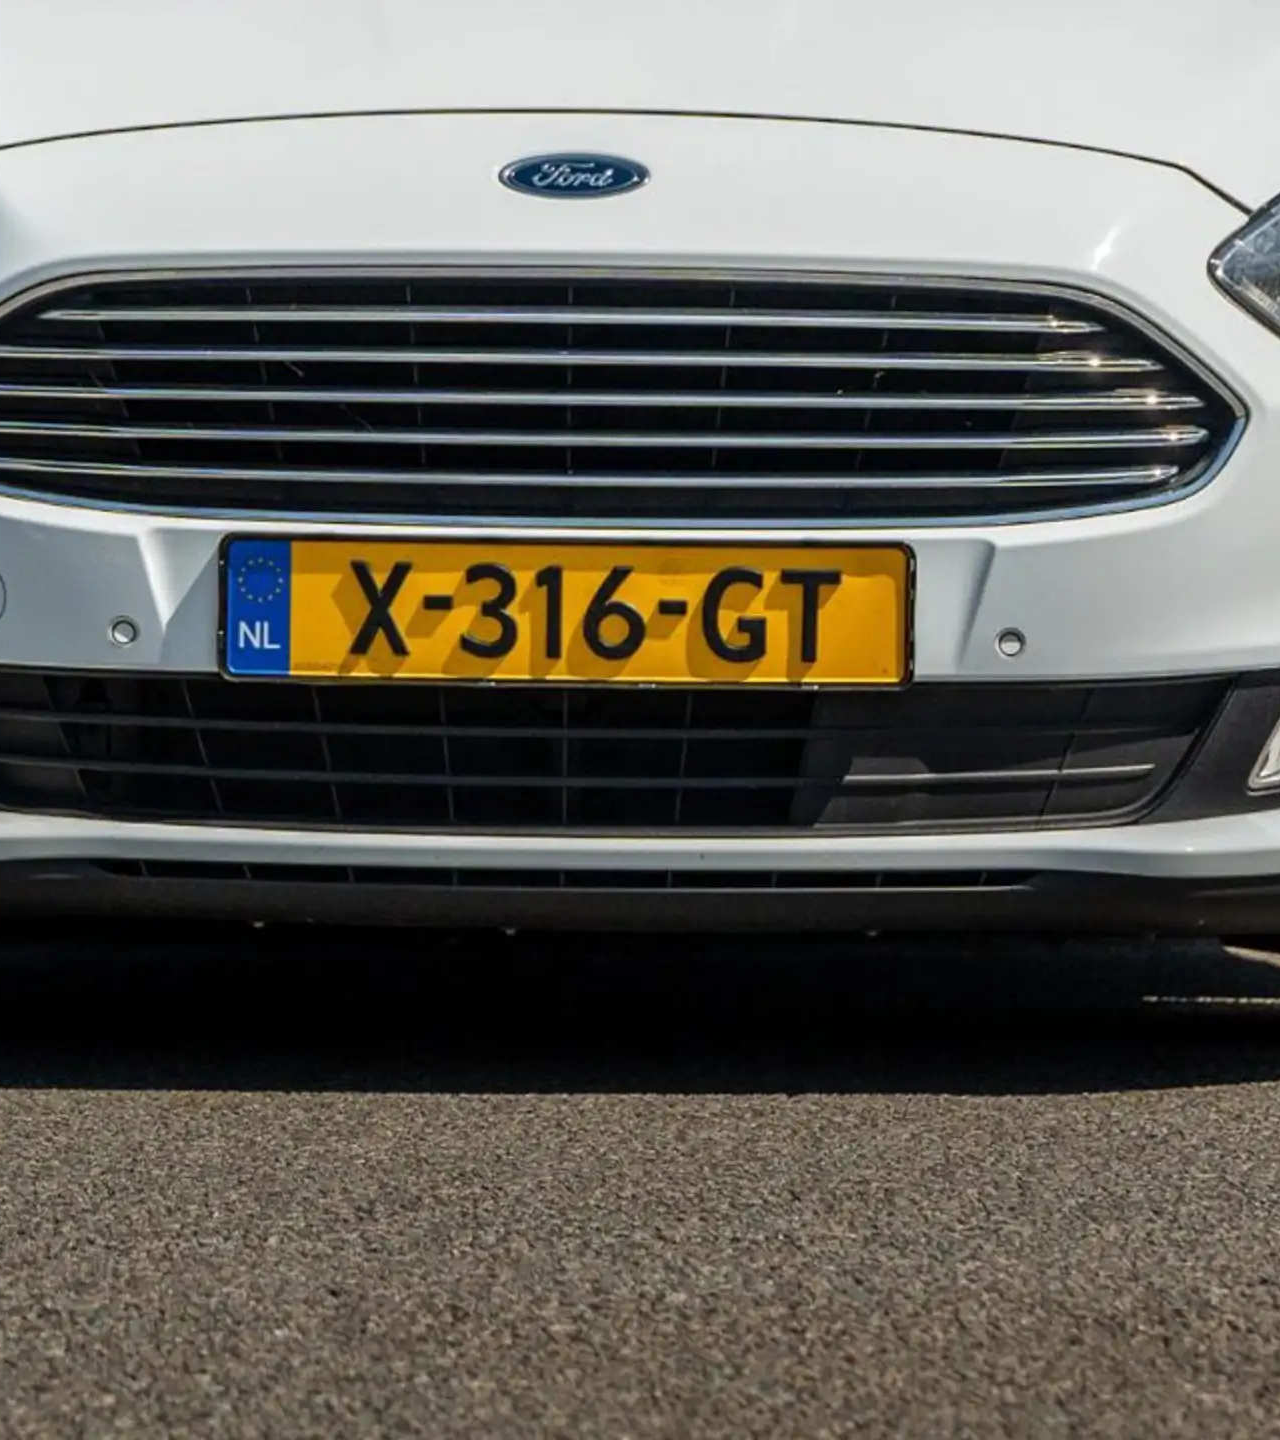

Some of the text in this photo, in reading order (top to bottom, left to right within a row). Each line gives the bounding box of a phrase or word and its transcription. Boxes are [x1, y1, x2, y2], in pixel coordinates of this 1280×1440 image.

[531, 162, 615, 188] Ford
[237, 560, 842, 664] NL X-316-GT
